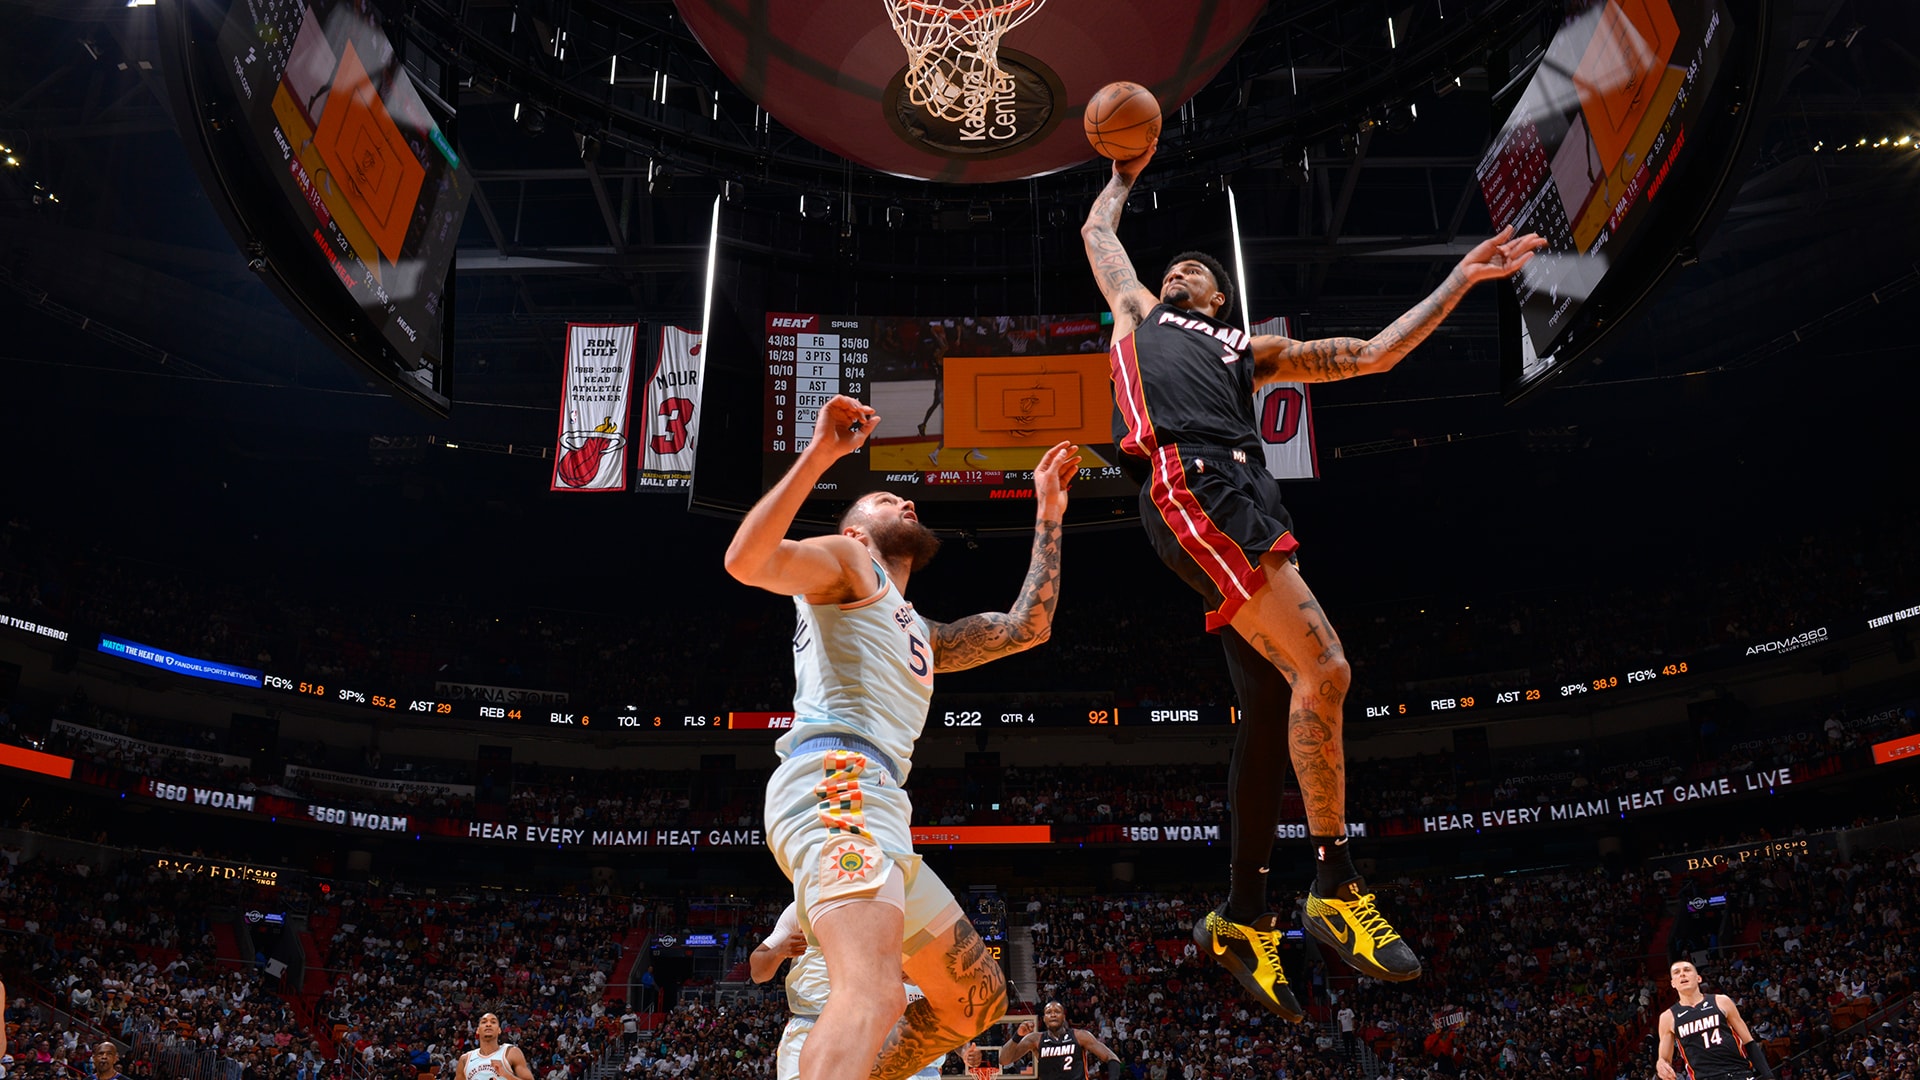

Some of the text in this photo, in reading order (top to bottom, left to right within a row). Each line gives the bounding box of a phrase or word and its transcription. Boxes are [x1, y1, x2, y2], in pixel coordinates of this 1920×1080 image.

[1686, 59, 1698, 84] SAS
[1677, 87, 1687, 103] 92
[959, 71, 989, 141] Kaseya
[989, 75, 1016, 140] Center
[1647, 164, 1670, 203] MIAMI
[1667, 123, 1686, 167] HEAT
[298, 167, 321, 206] MIA 112
[1627, 179, 1638, 198] 112
[1615, 197, 1627, 217] MIA
[313, 228, 337, 265] MIAMI
[335, 260, 358, 289] HEAT
[365, 271, 389, 304] 92 SAS
[1548, 296, 1572, 327] mph.com
[772, 316, 859, 329] HEAT SPURS
[1158, 311, 1250, 351] MIAMI
[587, 339, 616, 347] RON
[768, 335, 870, 350] 43/83 FG 35/80
[582, 348, 618, 357] CULP
[768, 350, 869, 365] 16/29 3 PTS 14/36
[1220, 344, 1241, 365] 7
[574, 366, 623, 374] 1988 2008
[768, 365, 865, 379] 10/10 FT 8/14
[572, 385, 622, 393] ATHLETIC
[656, 370, 697, 390] MOUR
[774, 380, 861, 393] 29 AST 23
[774, 395, 786, 405] 10
[799, 395, 817, 405] OFF
[776, 410, 783, 420] 6
[776, 425, 783, 436] 9
[773, 440, 786, 451] 50
[640, 478, 664, 487] HALL
[667, 478, 678, 487] OF
[940, 471, 960, 480] MIA
[966, 470, 982, 480] 112
[1079, 468, 1091, 477] 92
[1101, 466, 1122, 476] SAS
[989, 488, 1033, 499] MIAMI
[1867, 605, 1920, 629] TERRY ROZIE
[10, 616, 68, 641] TYLER HERRO!
[1745, 627, 1828, 656] AROMA360
[1778, 636, 1829, 654] LUXURY SCENTING
[102, 639, 258, 681] WATCH THE HEAT ON FANDUEL SPORTS NETWORK
[909, 633, 928, 677] 5
[1366, 662, 1688, 718] BLK 5 REB 39 AST 23 3P% 38.9 FG% 43.8
[264, 675, 294, 691] FG%
[299, 682, 325, 696] 51.8
[338, 689, 366, 704] 3P%
[371, 695, 397, 709] 55.2
[409, 700, 435, 713] AST
[436, 703, 452, 714] 29
[480, 706, 505, 719] REB
[507, 709, 523, 720] 44
[550, 712, 574, 725] BLK
[581, 715, 590, 727] 6
[617, 716, 641, 727] TOL
[653, 716, 662, 727] 3
[684, 716, 706, 727] FLS
[713, 716, 721, 727] 2
[943, 709, 1199, 726] 5:22 QTR 4 92 SPURS
[56, 723, 77, 734] NEED
[311, 770, 359, 785] ASSISTANCE?
[360, 778, 377, 788] TEXT
[379, 781, 390, 789] US
[390, 782, 400, 790] AT
[155, 783, 187, 802] 560
[1423, 768, 1793, 832] HEAR EVERY MIAMI HEAT GAME. LIVE
[315, 806, 345, 825] 560
[468, 822, 766, 846] HEAR EVERY MIAMI HEAT GAME.
[1131, 826, 1159, 841] 560
[1277, 824, 1305, 839] 560
[1446, 1012, 1464, 1026] LOUD
[1678, 1014, 1720, 1038] MIAMI
[1701, 1028, 1723, 1049] 14
[1041, 1044, 1075, 1058] MIAMI
[1063, 1055, 1074, 1070] 2
